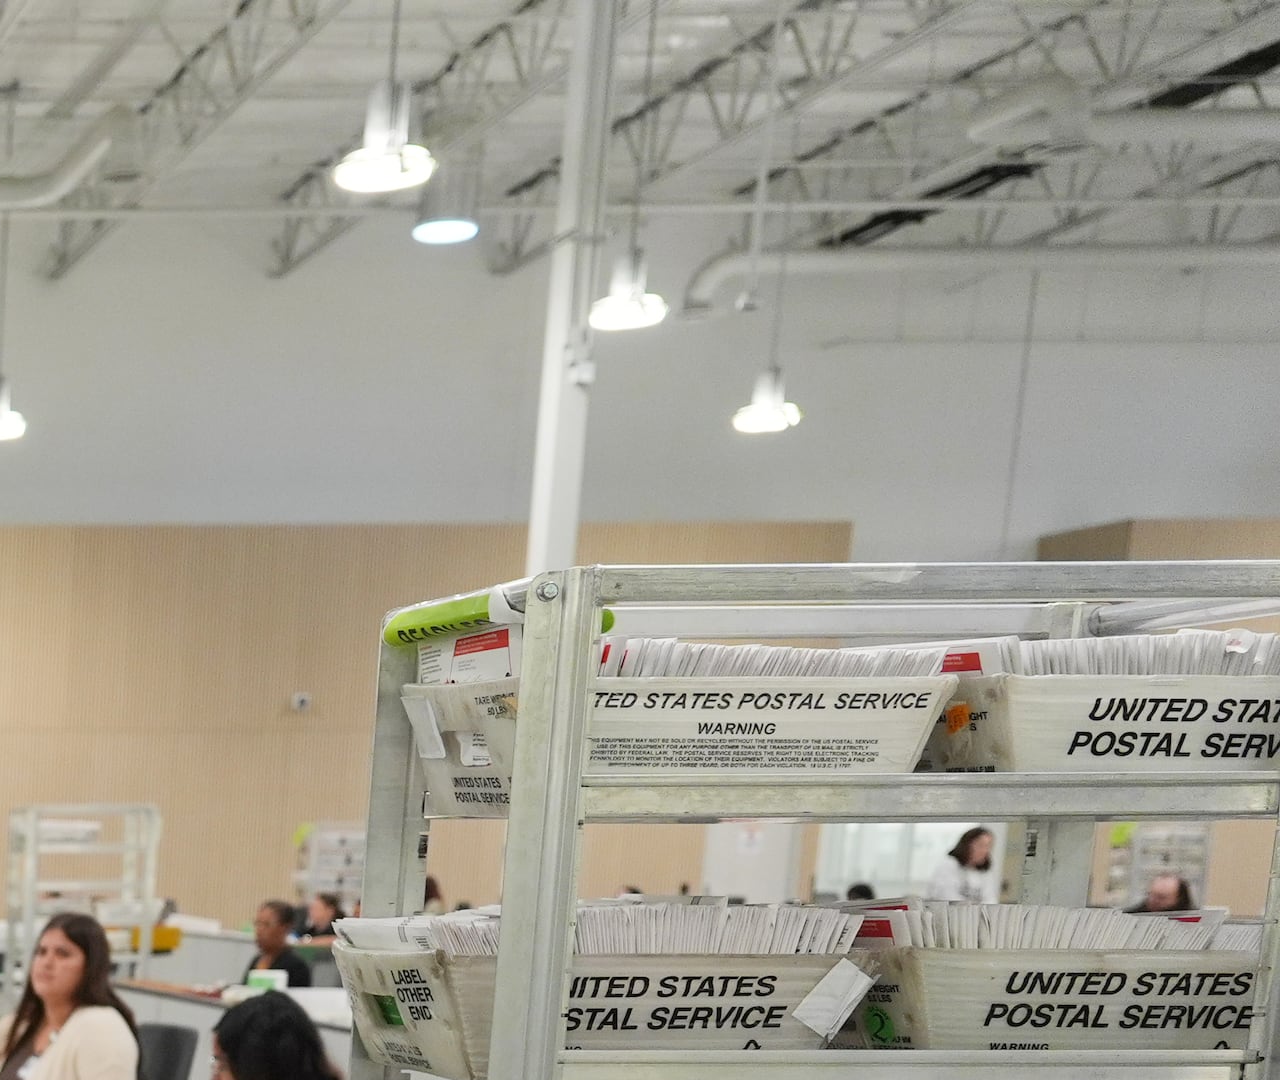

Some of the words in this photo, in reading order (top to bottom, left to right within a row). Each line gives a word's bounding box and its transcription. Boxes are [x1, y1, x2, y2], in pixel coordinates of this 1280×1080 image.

[644, 693, 733, 709] STATES
[738, 693, 825, 709] POSTAL
[834, 693, 931, 709] SERVICE
[1089, 698, 1208, 722] UNITED
[1213, 699, 1280, 723] STAT
[699, 723, 776, 734] WARNING
[1068, 732, 1190, 756] POSTAL
[478, 777, 501, 789] STATES
[391, 969, 426, 984] LABEL
[1006, 972, 1127, 995] UNITED
[1133, 973, 1253, 996] STATES
[397, 987, 434, 1002] OTHER
[658, 976, 777, 997] STATES
[408, 1006, 432, 1020] END
[648, 1006, 787, 1030] SERVICE
[984, 1004, 1108, 1028] POSTAL
[1119, 1005, 1255, 1029] SERVICE
